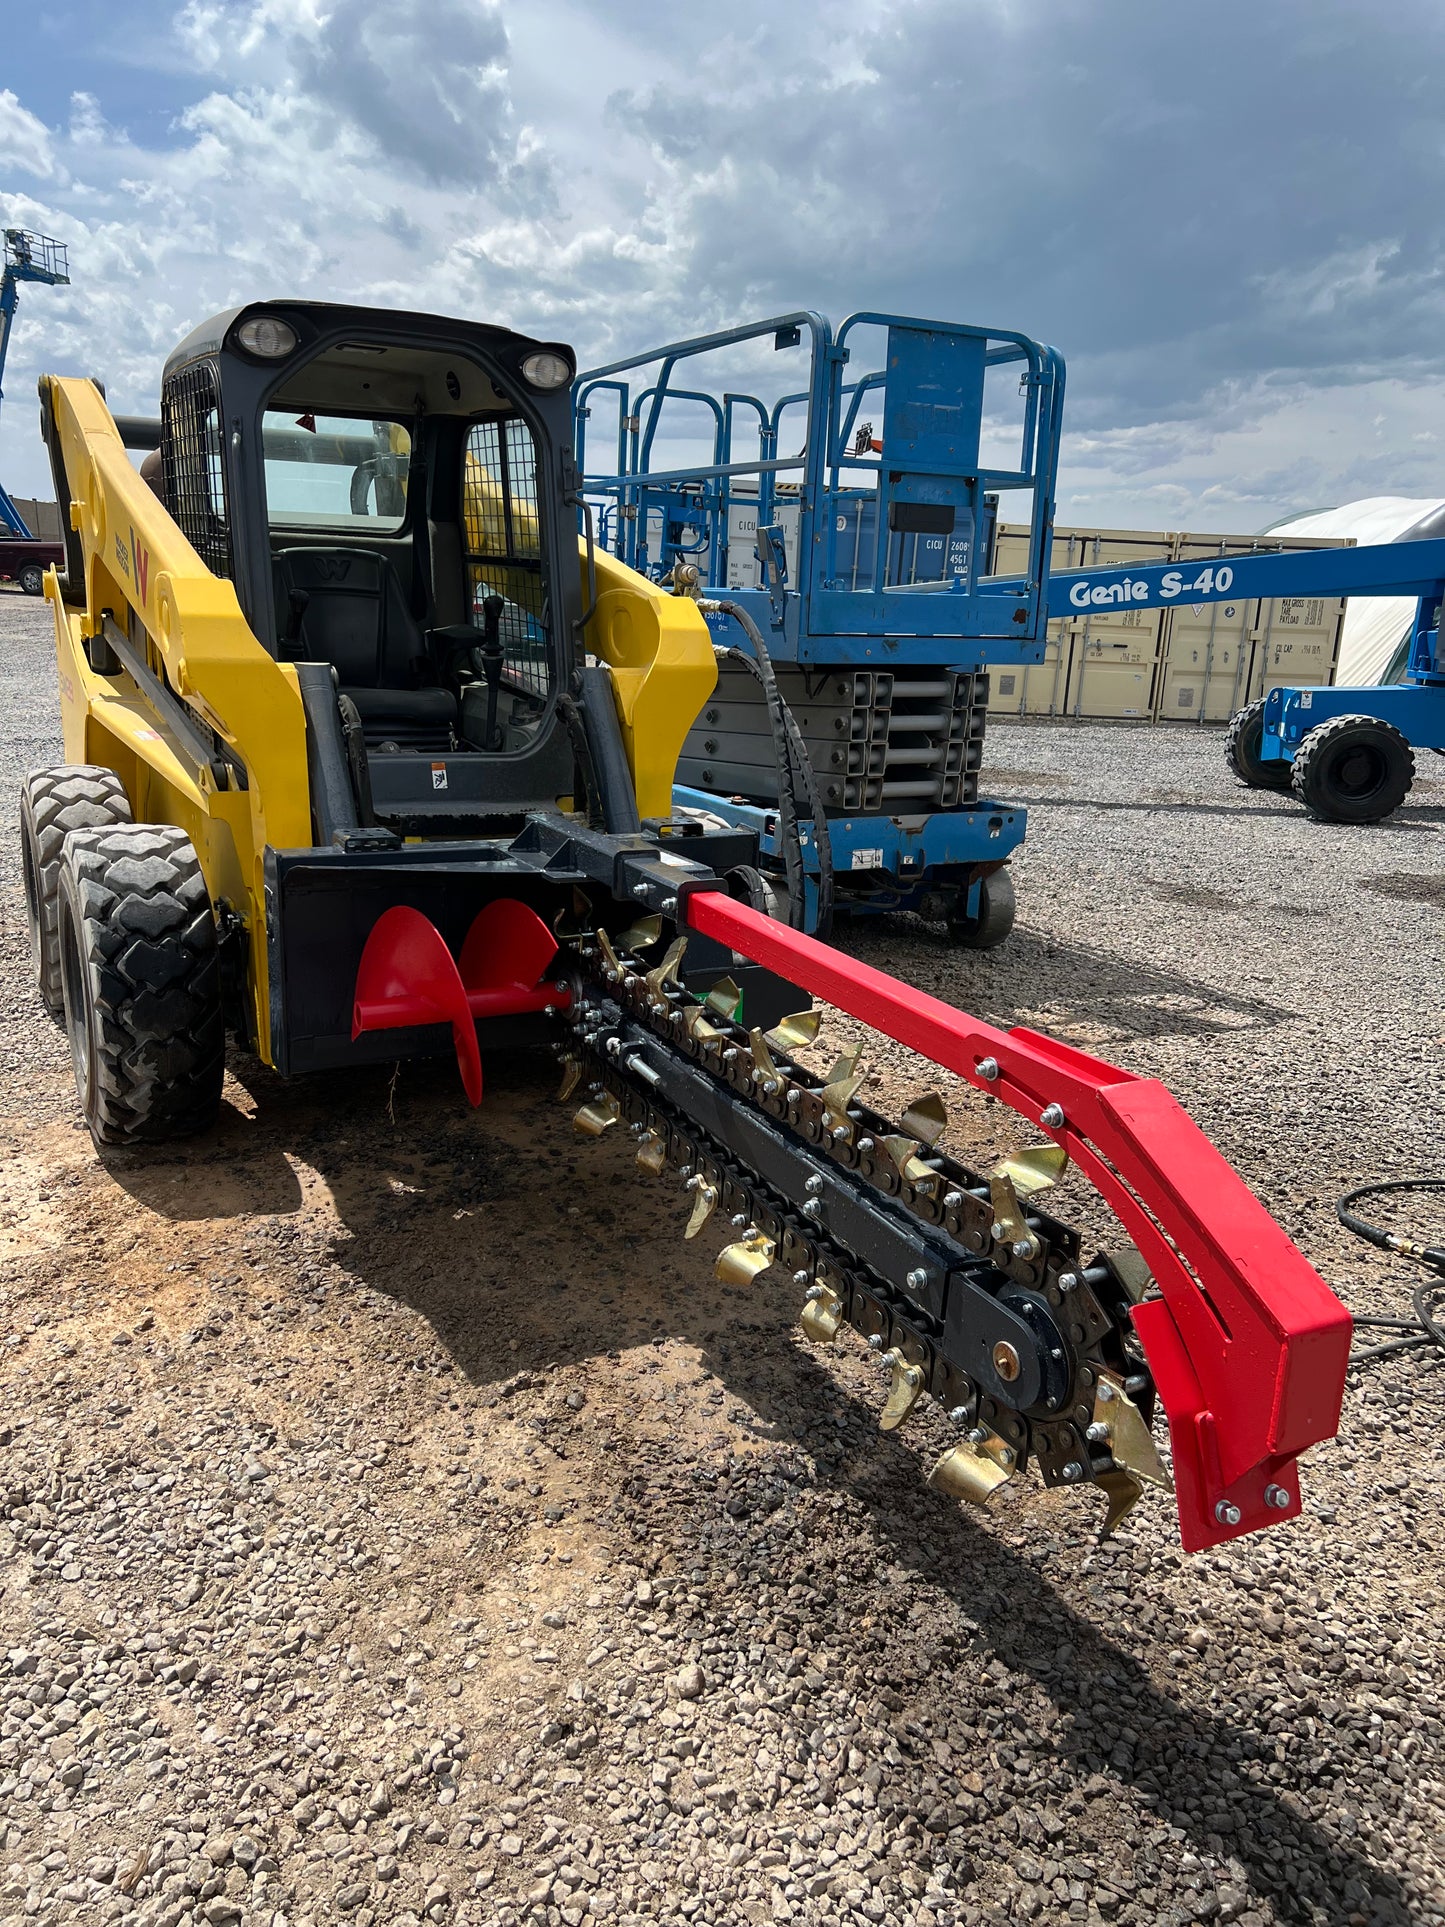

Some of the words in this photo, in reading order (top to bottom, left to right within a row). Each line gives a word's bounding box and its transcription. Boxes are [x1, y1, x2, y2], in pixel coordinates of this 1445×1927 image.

[926, 540, 943, 550] CICU
[950, 554, 967, 565] 45G1
[1069, 577, 1149, 608] Genie
[1158, 566, 1234, 598] S-40
